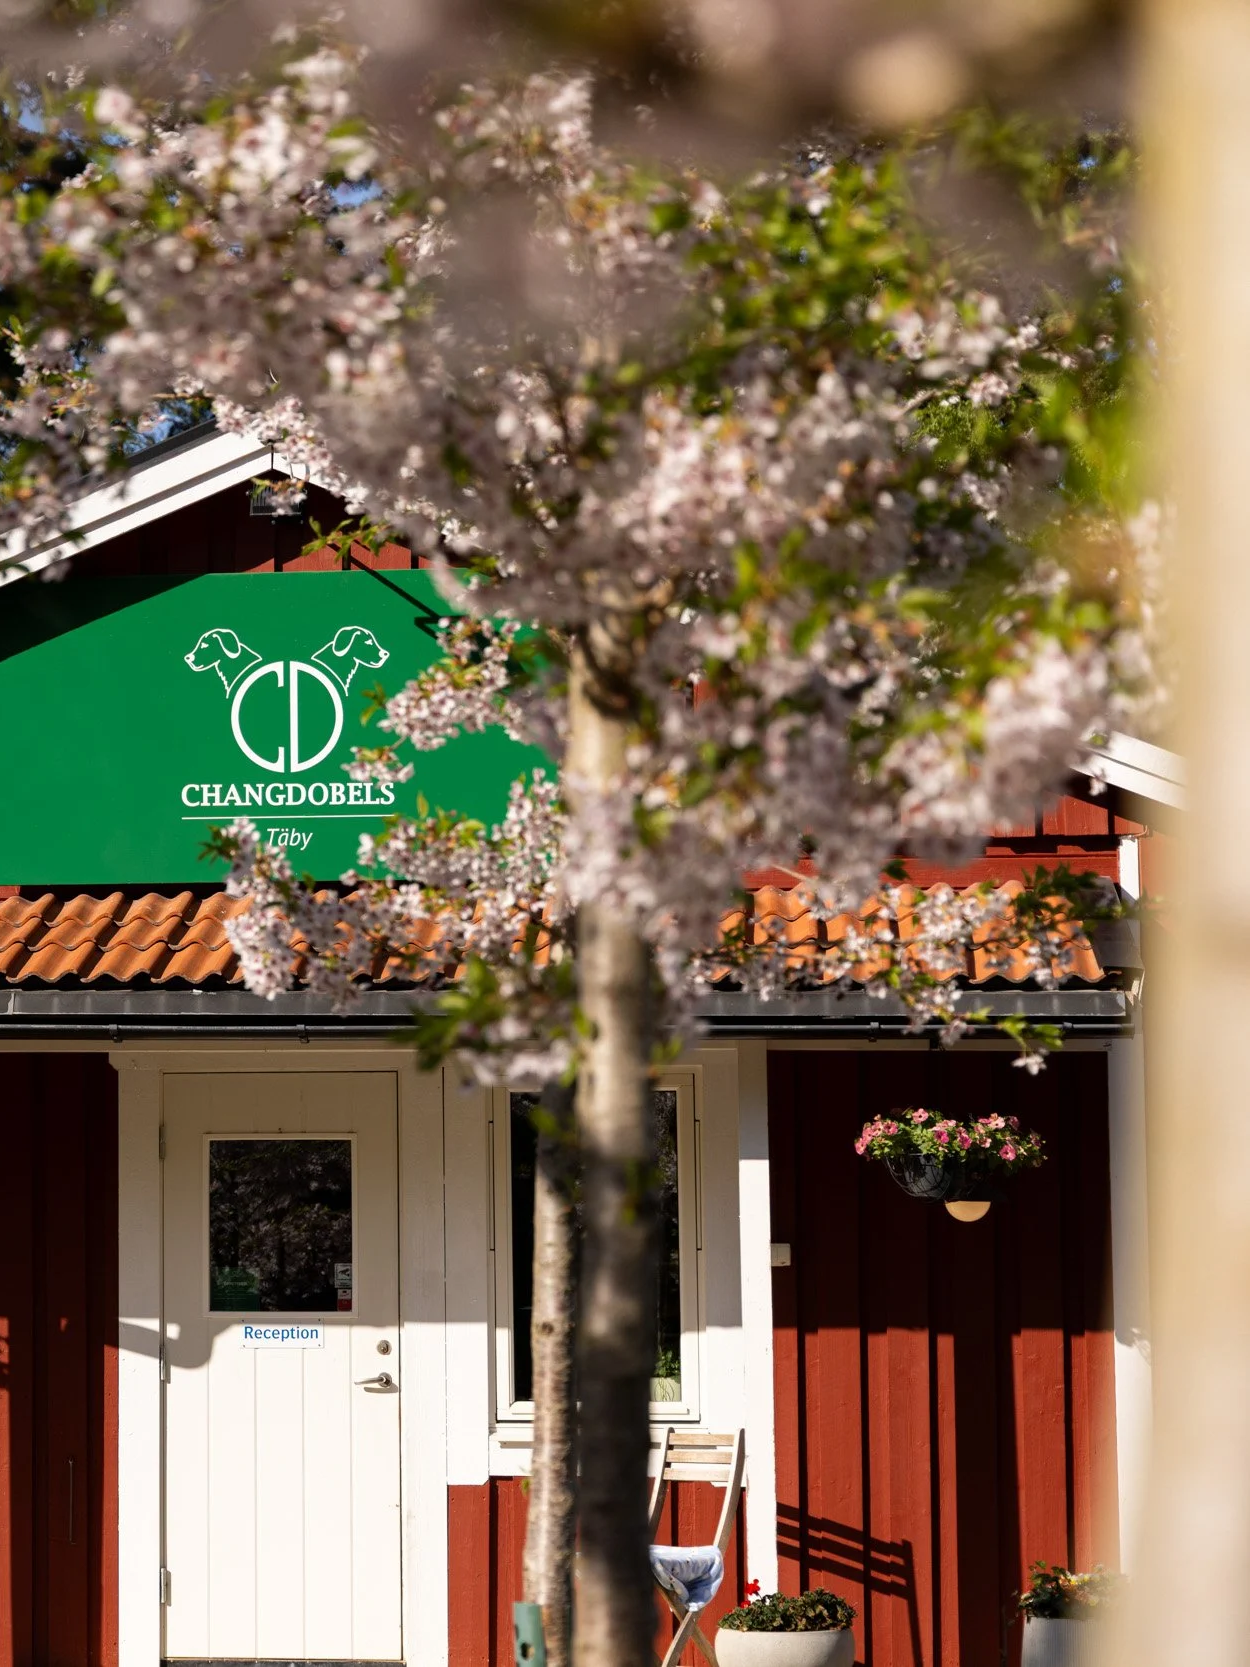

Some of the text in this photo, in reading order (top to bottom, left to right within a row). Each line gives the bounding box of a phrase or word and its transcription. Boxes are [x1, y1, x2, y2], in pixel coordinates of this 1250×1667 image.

[231, 660, 344, 773] CD
[181, 782, 396, 807] CHANGDOBELS
[266, 827, 314, 851] Täby
[244, 1325, 319, 1342] Reception
